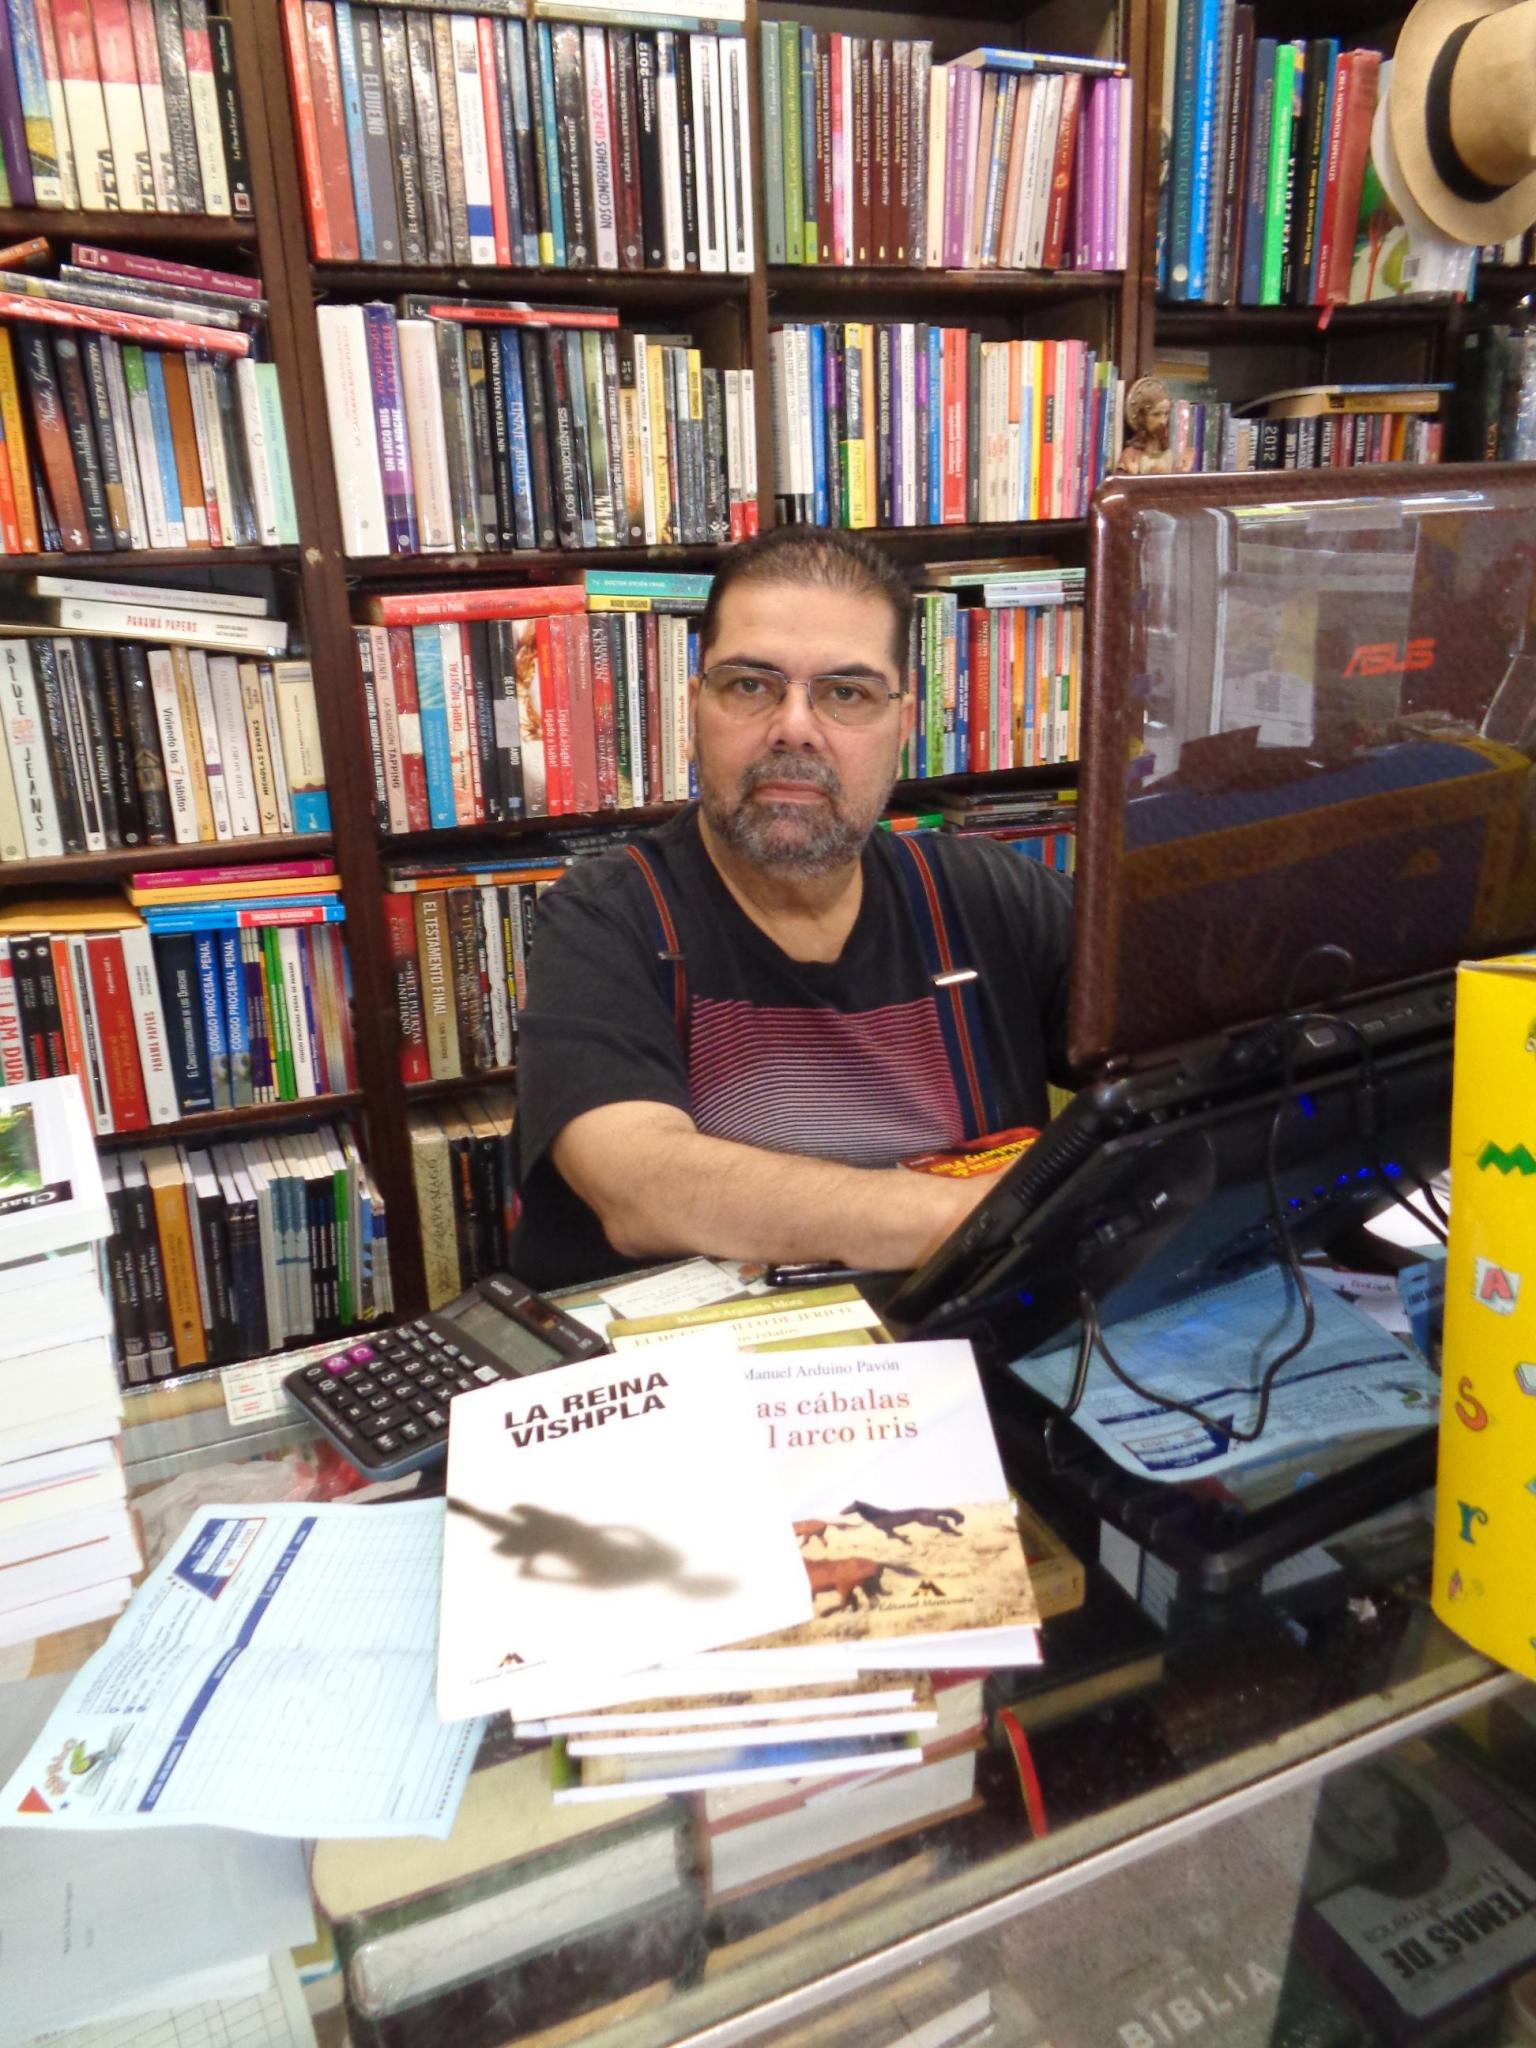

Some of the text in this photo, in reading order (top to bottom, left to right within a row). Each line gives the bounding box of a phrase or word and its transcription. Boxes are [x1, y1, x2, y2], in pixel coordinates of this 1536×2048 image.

[643, 78, 651, 133] APOCALIPSIS
[1179, 89, 1193, 157] MUNDO
[1332, 93, 1343, 137] MOMENTOS
[399, 154, 416, 217] IMPOSTOR
[595, 140, 609, 205] COMPRAMOS
[30, 340, 60, 432] Nicole Jordan
[73, 424, 97, 469] prohibido
[392, 408, 403, 442] NOCHE
[1263, 426, 1277, 461] 2012
[558, 407, 573, 490] PADECIENTES
[85, 472, 102, 504] mundo
[165, 619, 197, 633] PAPERS
[592, 628, 606, 679] KENYON
[1342, 638, 1437, 679] ASUS
[449, 662, 460, 701] MORTAL
[545, 709, 556, 736] Legado
[559, 709, 569, 736] Legado
[96, 745, 109, 780] TIZNADA
[161, 707, 176, 747] Viviendo
[174, 779, 188, 813] hábitos
[388, 749, 400, 788] TAPPING
[547, 745, 557, 768] Isabel
[679, 735, 688, 765] complejo
[24, 747, 44, 831] JEANS
[258, 755, 269, 796] NICHOLAS
[425, 917, 443, 984] TESTAMENTO
[200, 941, 220, 1051] CÓDIGO PROCESAL PENAL
[224, 939, 242, 1049] CÓDIGO PROCESAL PENAL
[397, 983, 411, 1035] INFIERNO
[406, 971, 422, 1044] SIETE PUERTAS
[430, 986, 447, 1017] FINAL
[143, 1011, 157, 1039] PAPERS
[0, 1015, 24, 1086] AM DUR
[1480, 1268, 1513, 1300] A
[796, 1357, 901, 1379] Arduino Pavón
[504, 1371, 670, 1429] LA REINA
[510, 1394, 667, 1449] VISHPLA
[797, 1388, 911, 1416] cábalas
[1454, 1376, 1489, 1431] S
[787, 1418, 919, 1448] arco iris
[1458, 1500, 1488, 1544] r
[1383, 1870, 1536, 1978] TEMAS DE
[1118, 1960, 1281, 2048] BIBLIA
